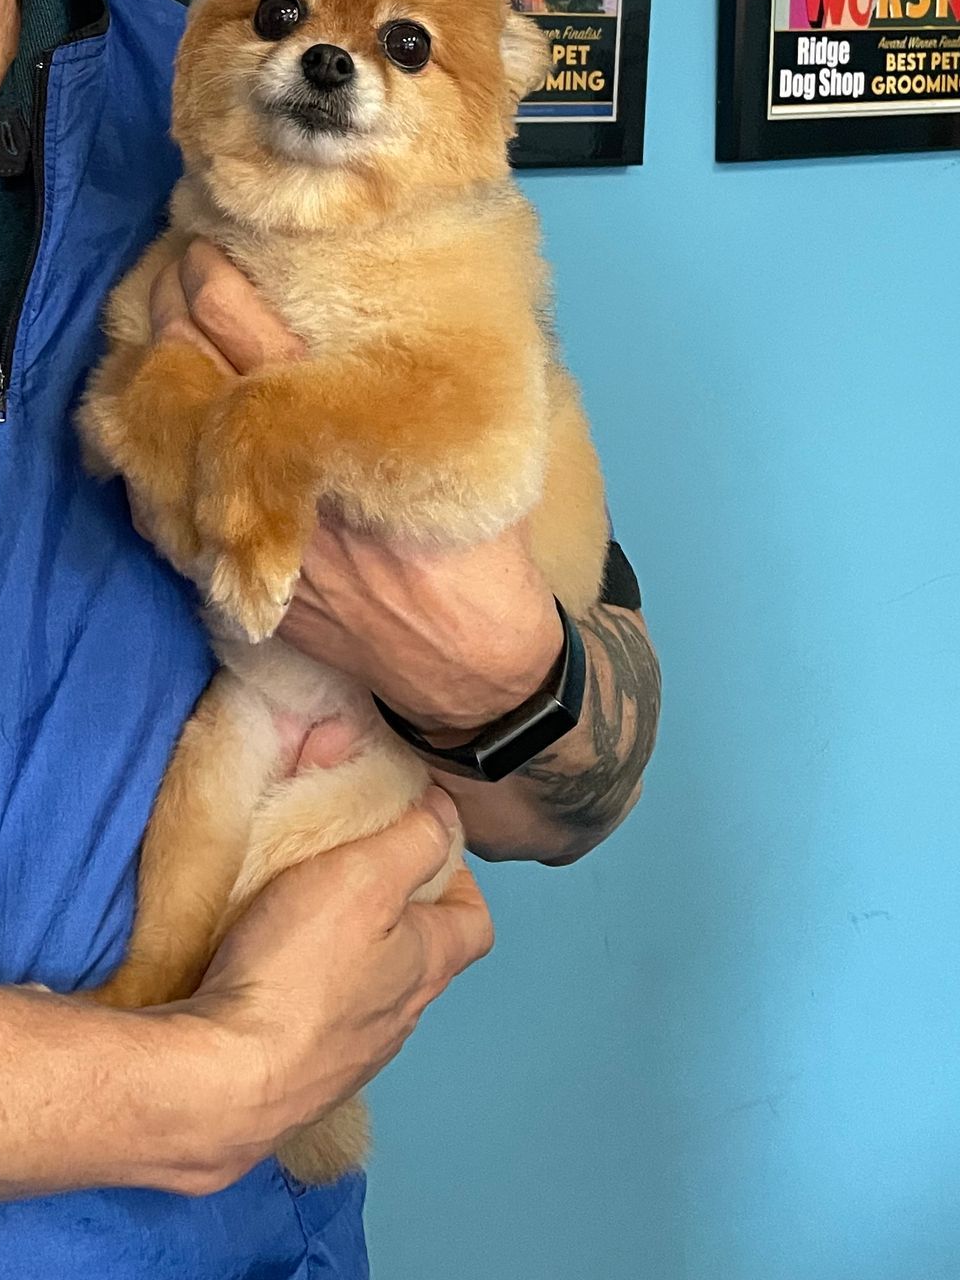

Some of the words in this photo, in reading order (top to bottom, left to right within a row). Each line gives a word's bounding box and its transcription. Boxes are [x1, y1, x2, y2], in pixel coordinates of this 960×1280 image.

[562, 26, 603, 41] Finalist
[878, 36, 908, 49] Award
[552, 44, 591, 66] PET
[797, 36, 851, 68] Ridge
[886, 52, 927, 72] BEST
[931, 52, 960, 70] PET
[545, 70, 606, 92] MING
[779, 69, 816, 101] Dog
[819, 68, 865, 98] Shop
[871, 74, 960, 95] GROOMIN
